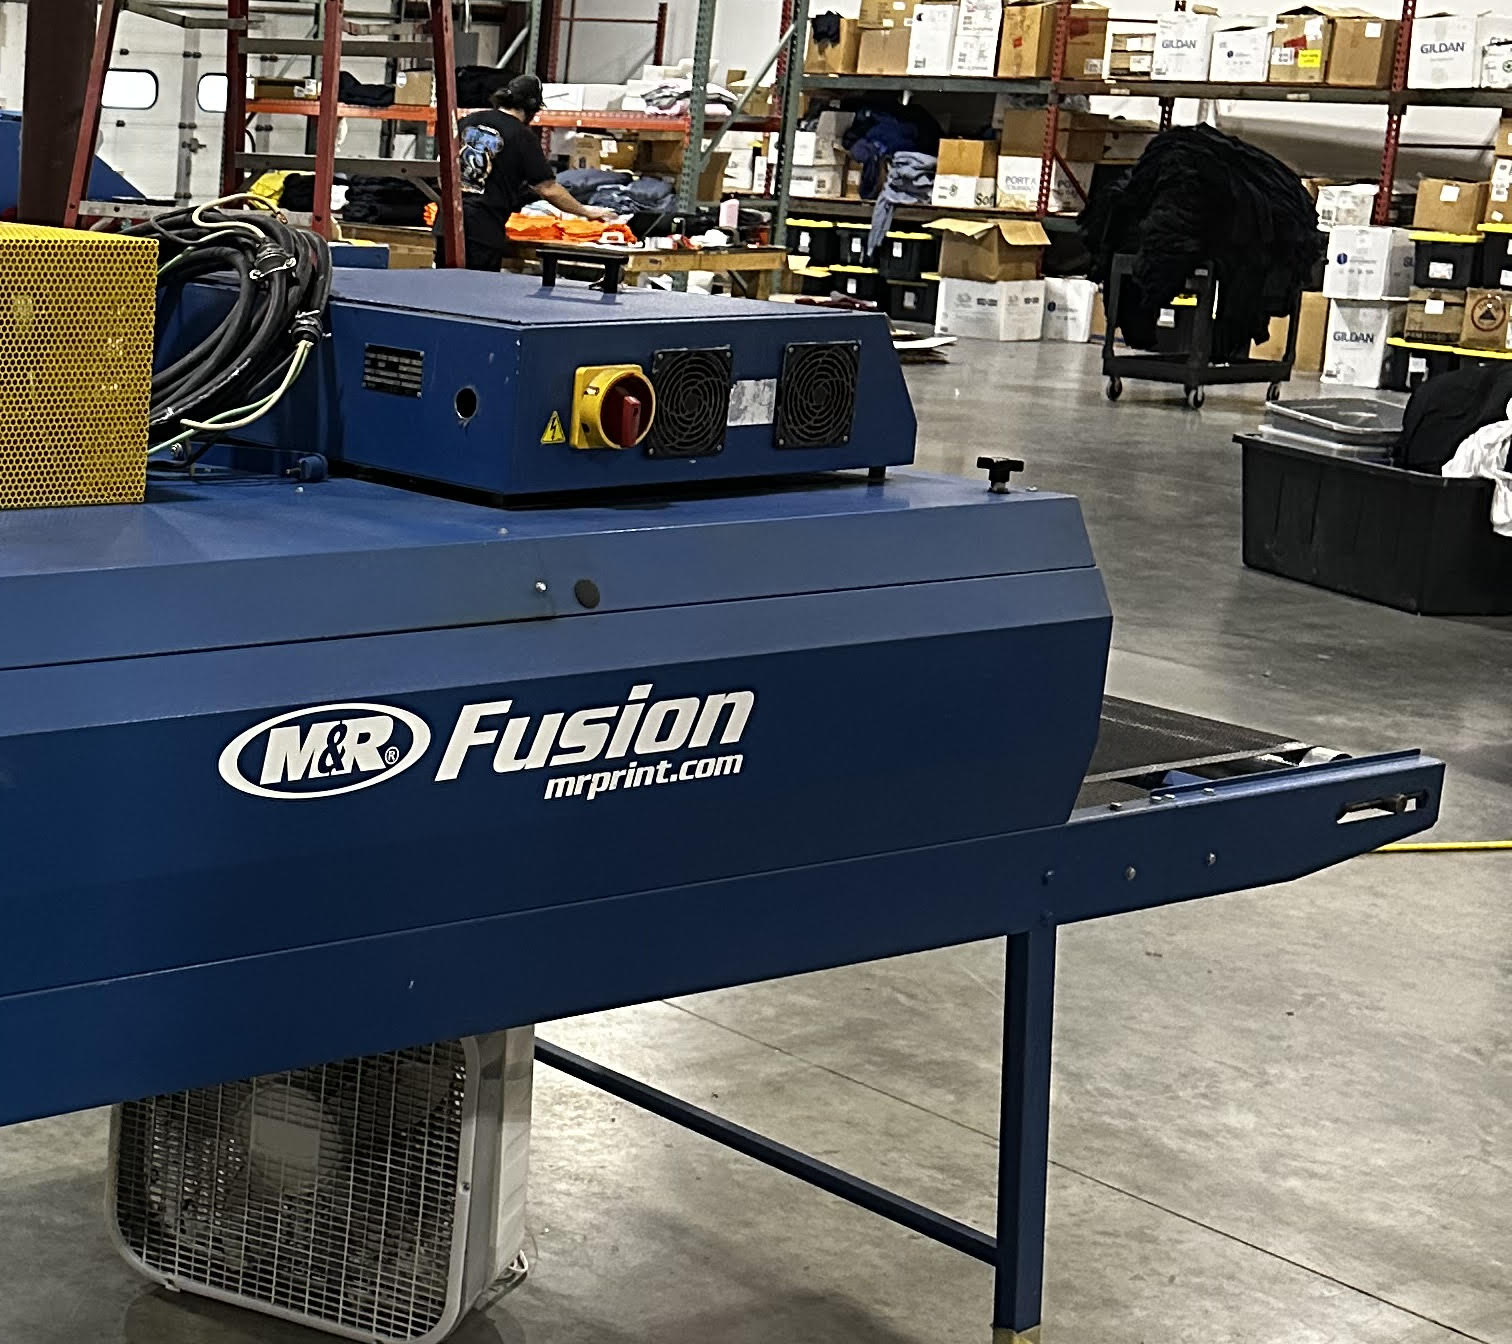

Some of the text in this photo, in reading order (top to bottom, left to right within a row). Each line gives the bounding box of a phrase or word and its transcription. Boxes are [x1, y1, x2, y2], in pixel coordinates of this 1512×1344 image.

[1161, 39, 1198, 49] GILDAN
[1420, 42, 1465, 54] GILDAN
[1332, 331, 1374, 344] GILDAN
[434, 683, 755, 782] Fusion
[543, 753, 744, 800] mrprint.com
